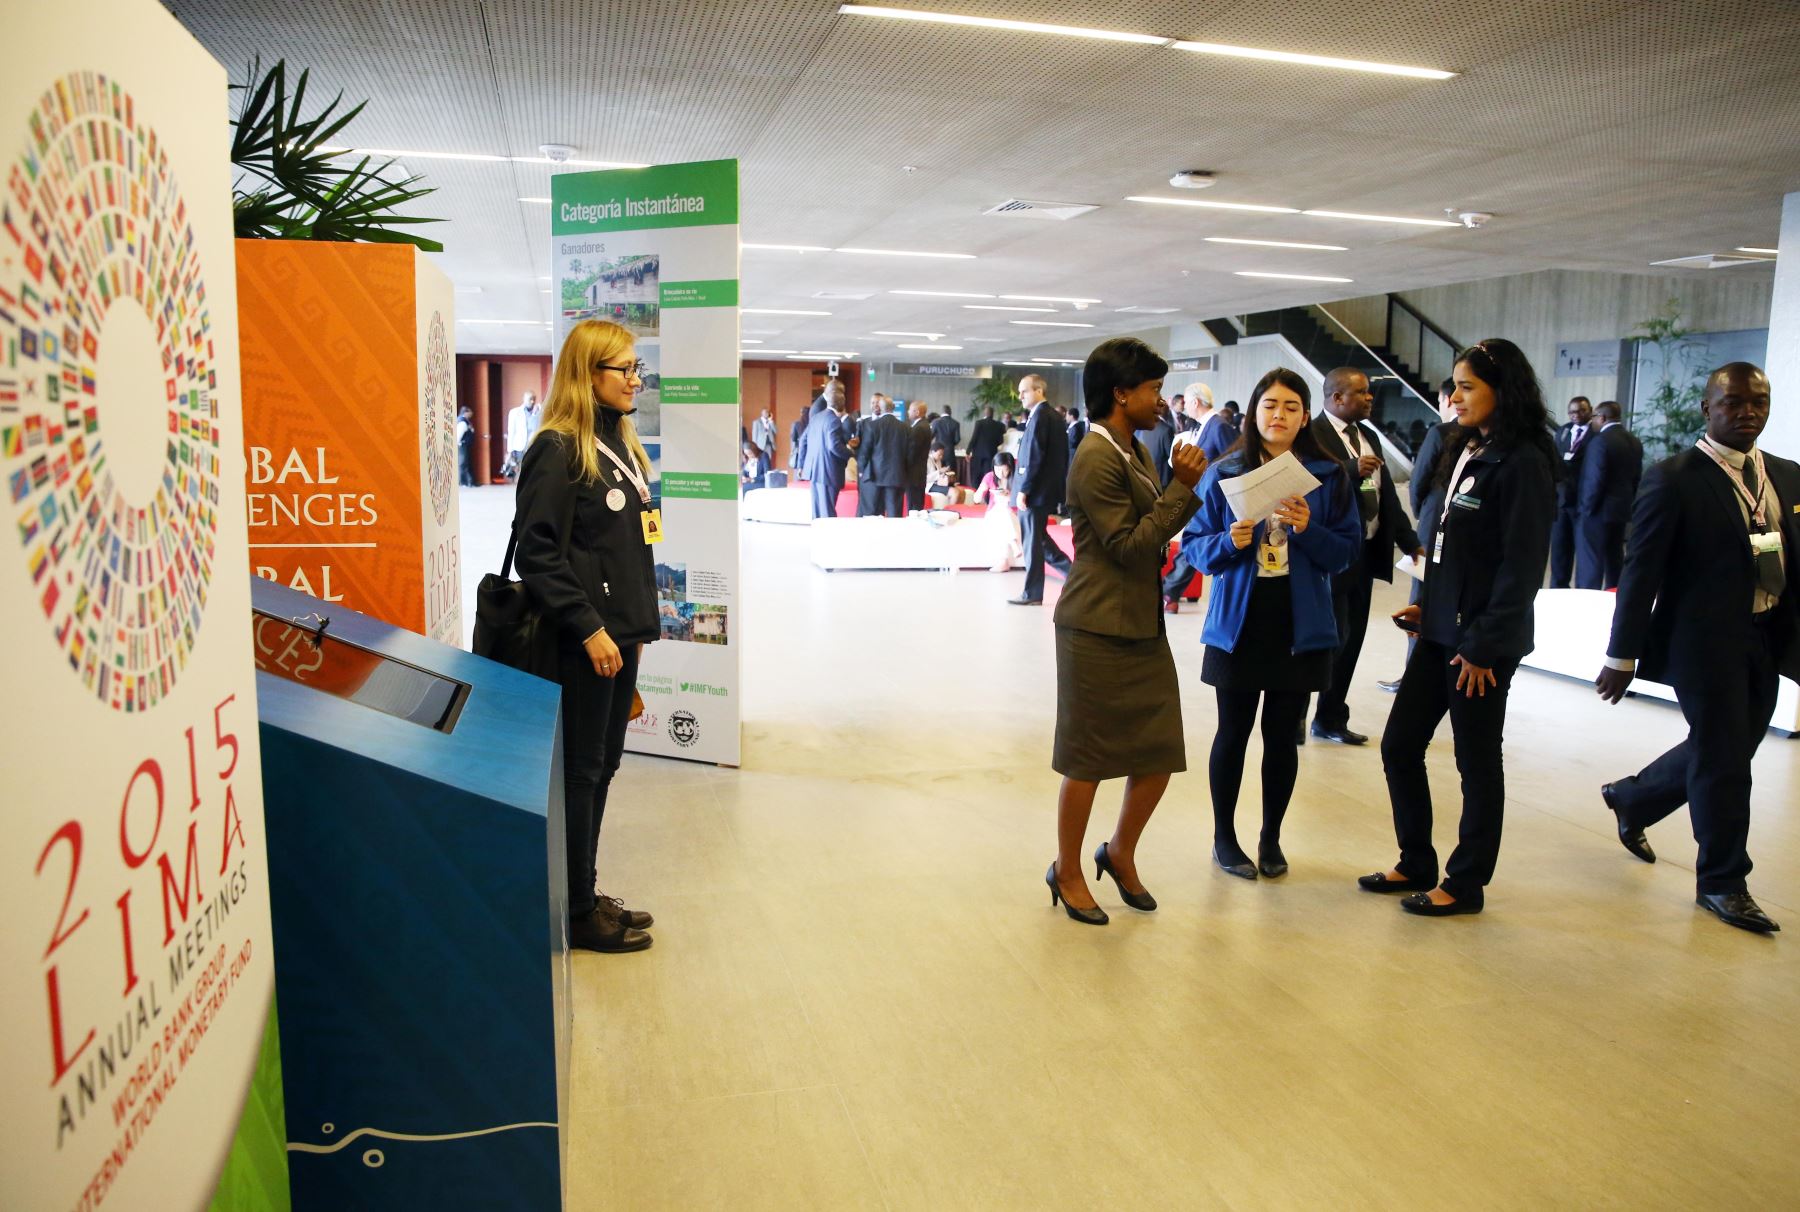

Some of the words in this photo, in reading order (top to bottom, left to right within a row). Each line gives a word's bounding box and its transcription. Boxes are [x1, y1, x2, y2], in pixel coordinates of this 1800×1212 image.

[561, 199, 621, 224] Categoría
[625, 193, 704, 217] Instantánea
[561, 242, 605, 255] Ganadores
[919, 366, 975, 375] PURUCHUCO
[244, 446, 339, 484] BAL
[429, 535, 457, 590] 2015
[430, 570, 459, 629] LIMA
[689, 683, 728, 697] #IMFYouth
[34, 693, 239, 962] 2015
[46, 783, 245, 1088] LIMA
[57, 980, 162, 1151] ANNUAL
[169, 860, 247, 994] MEETINGS
[179, 974, 228, 1072] MONETARY
[230, 938, 252, 988] FUND
[112, 1041, 161, 1127] WORLD
[164, 991, 194, 1054] BANK
[196, 943, 226, 1005] GROUP
